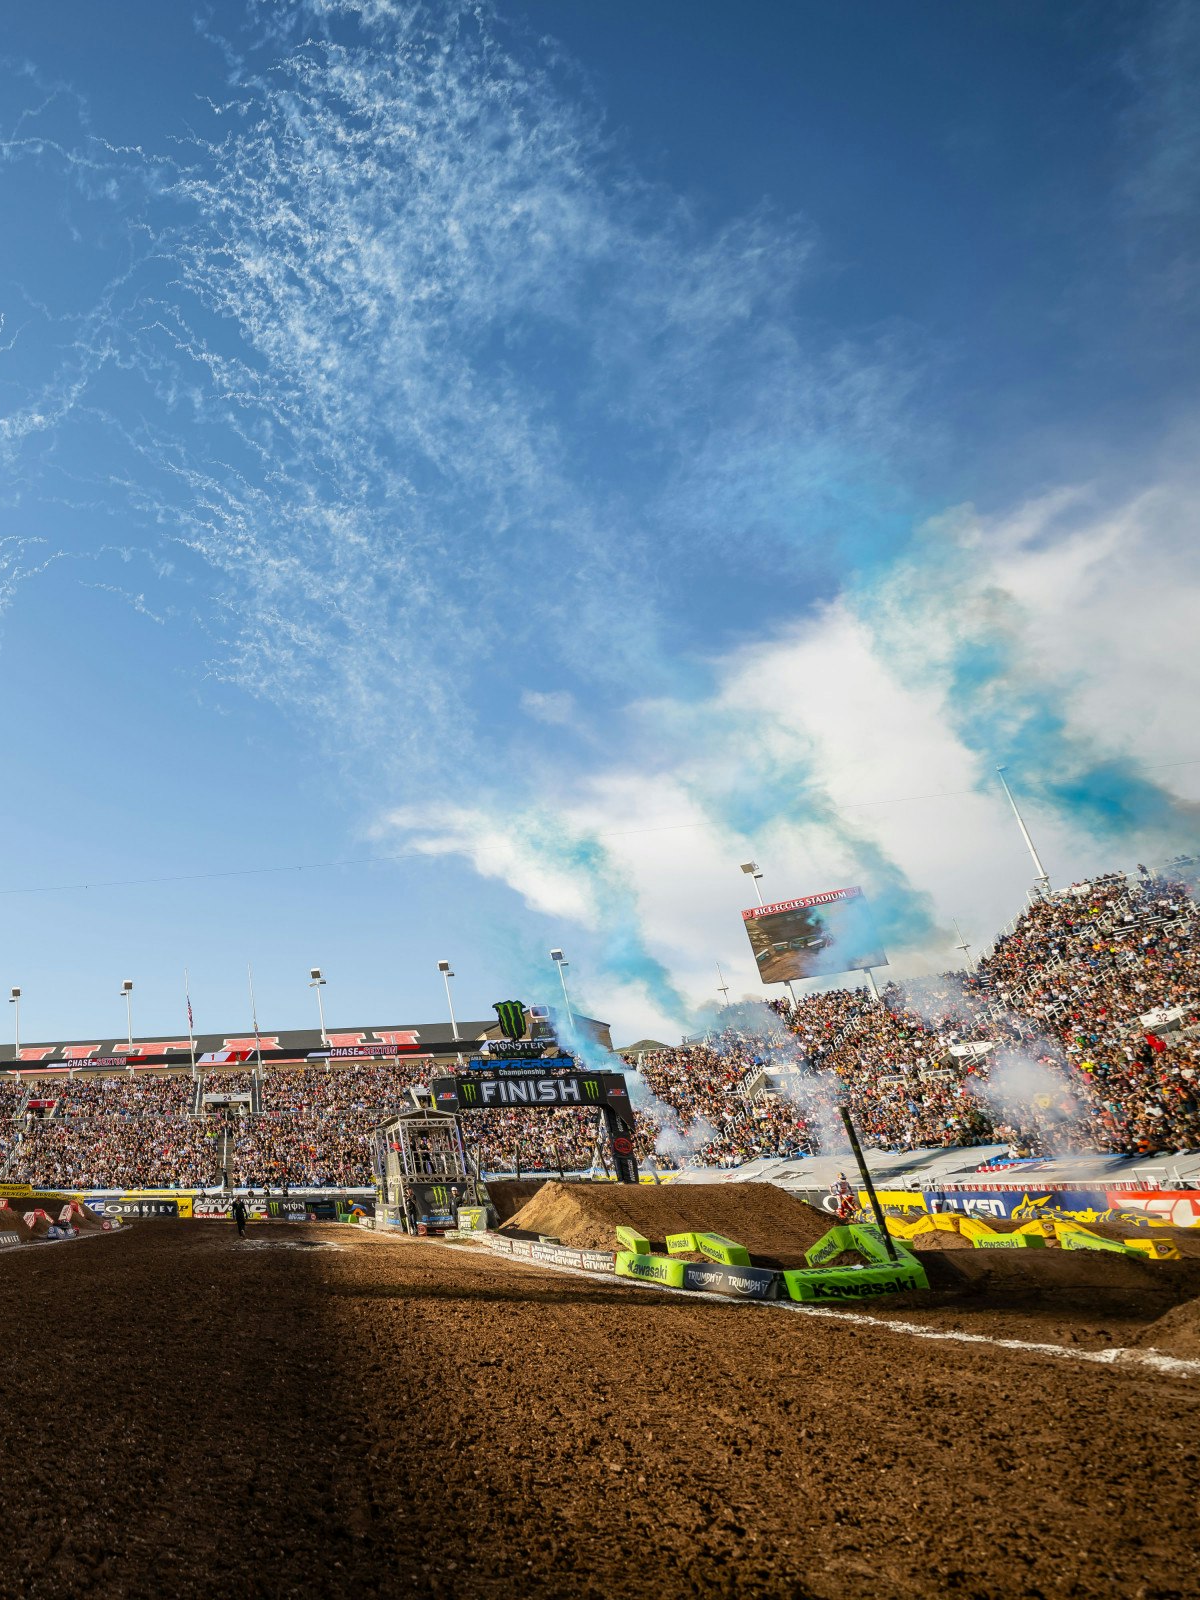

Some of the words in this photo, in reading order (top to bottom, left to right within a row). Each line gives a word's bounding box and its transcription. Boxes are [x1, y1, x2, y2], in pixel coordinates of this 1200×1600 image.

[754, 900, 805, 916] RICE-ECCLES
[805, 891, 847, 905] STADIUM
[1156, 1013, 1169, 1022] 32
[330, 1047, 359, 1056] CHASE
[363, 1045, 398, 1055] SEXTON
[490, 1042, 546, 1052] MONSTER
[965, 1045, 976, 1053] 31
[67, 1059, 93, 1068] CHASE
[96, 1057, 127, 1066] SEXTON
[469, 1059, 574, 1069] SUPERCROSS
[481, 1079, 581, 1102] FINISH
[124, 1205, 177, 1213] OAKLEY
[1, 1235, 19, 1244] OAKLEY
[668, 1239, 689, 1249] Kawasaki
[977, 1239, 1019, 1248] Kawasaki
[700, 1241, 725, 1260] Kawasaki
[809, 1236, 838, 1264] Kawasaki
[628, 1259, 667, 1280] Kawasaki
[688, 1270, 716, 1283] TRIUMPH
[728, 1275, 761, 1291] TRIUMPH
[811, 1276, 917, 1298] Kawasaki
